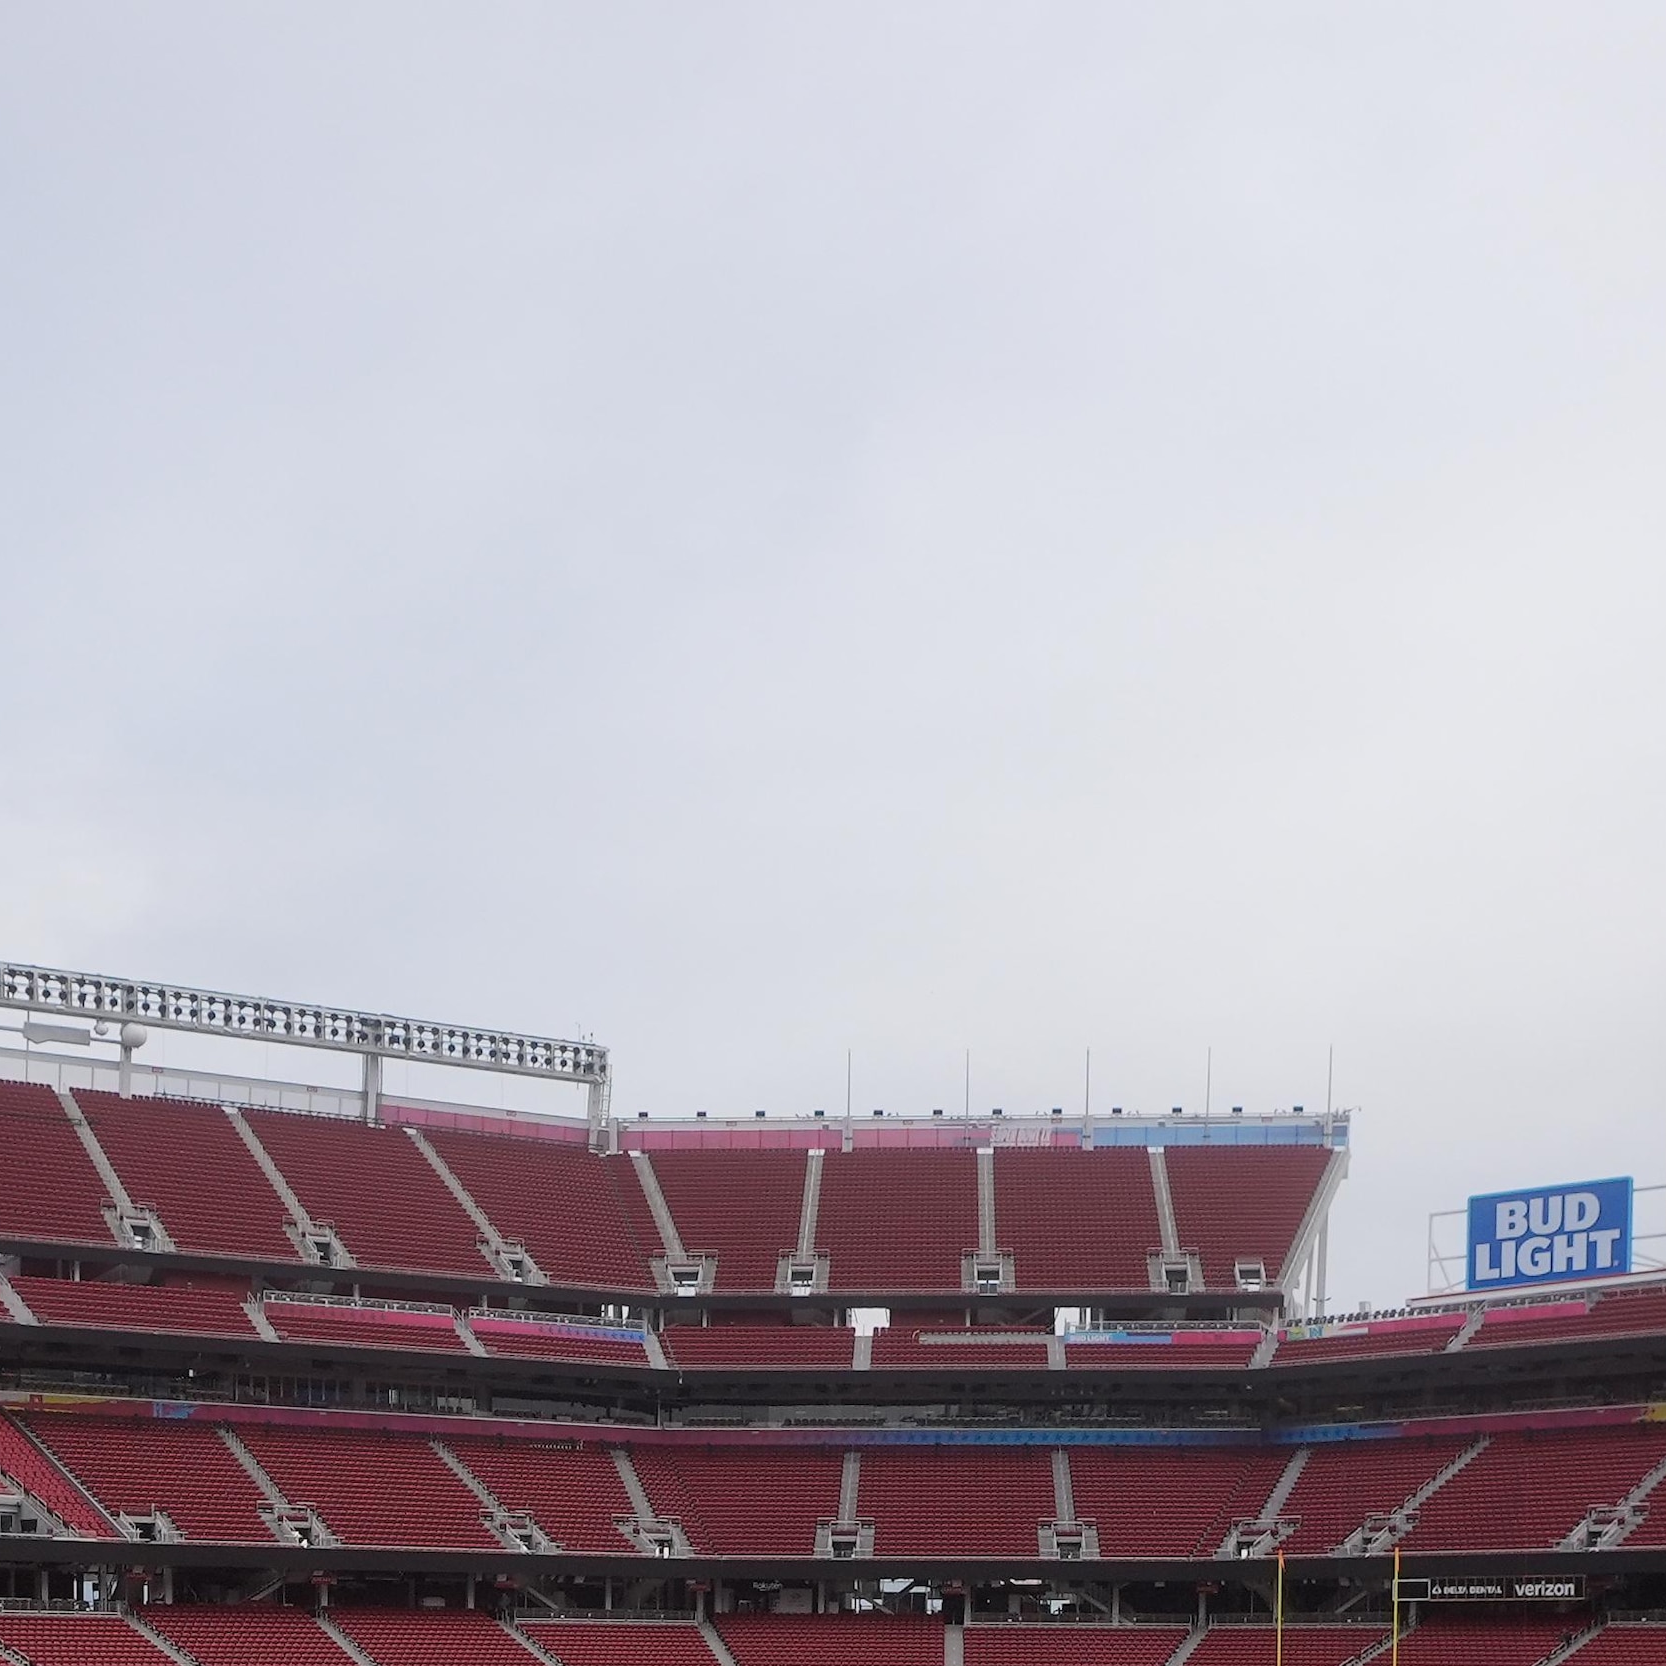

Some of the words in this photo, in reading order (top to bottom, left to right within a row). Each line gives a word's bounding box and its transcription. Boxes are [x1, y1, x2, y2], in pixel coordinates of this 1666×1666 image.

[1495, 1192, 1601, 1240] BUD
[1475, 1229, 1621, 1281] LIGHT
[1469, 1584, 1503, 1594] DENTAL
[1515, 1580, 1575, 1597] verizon
